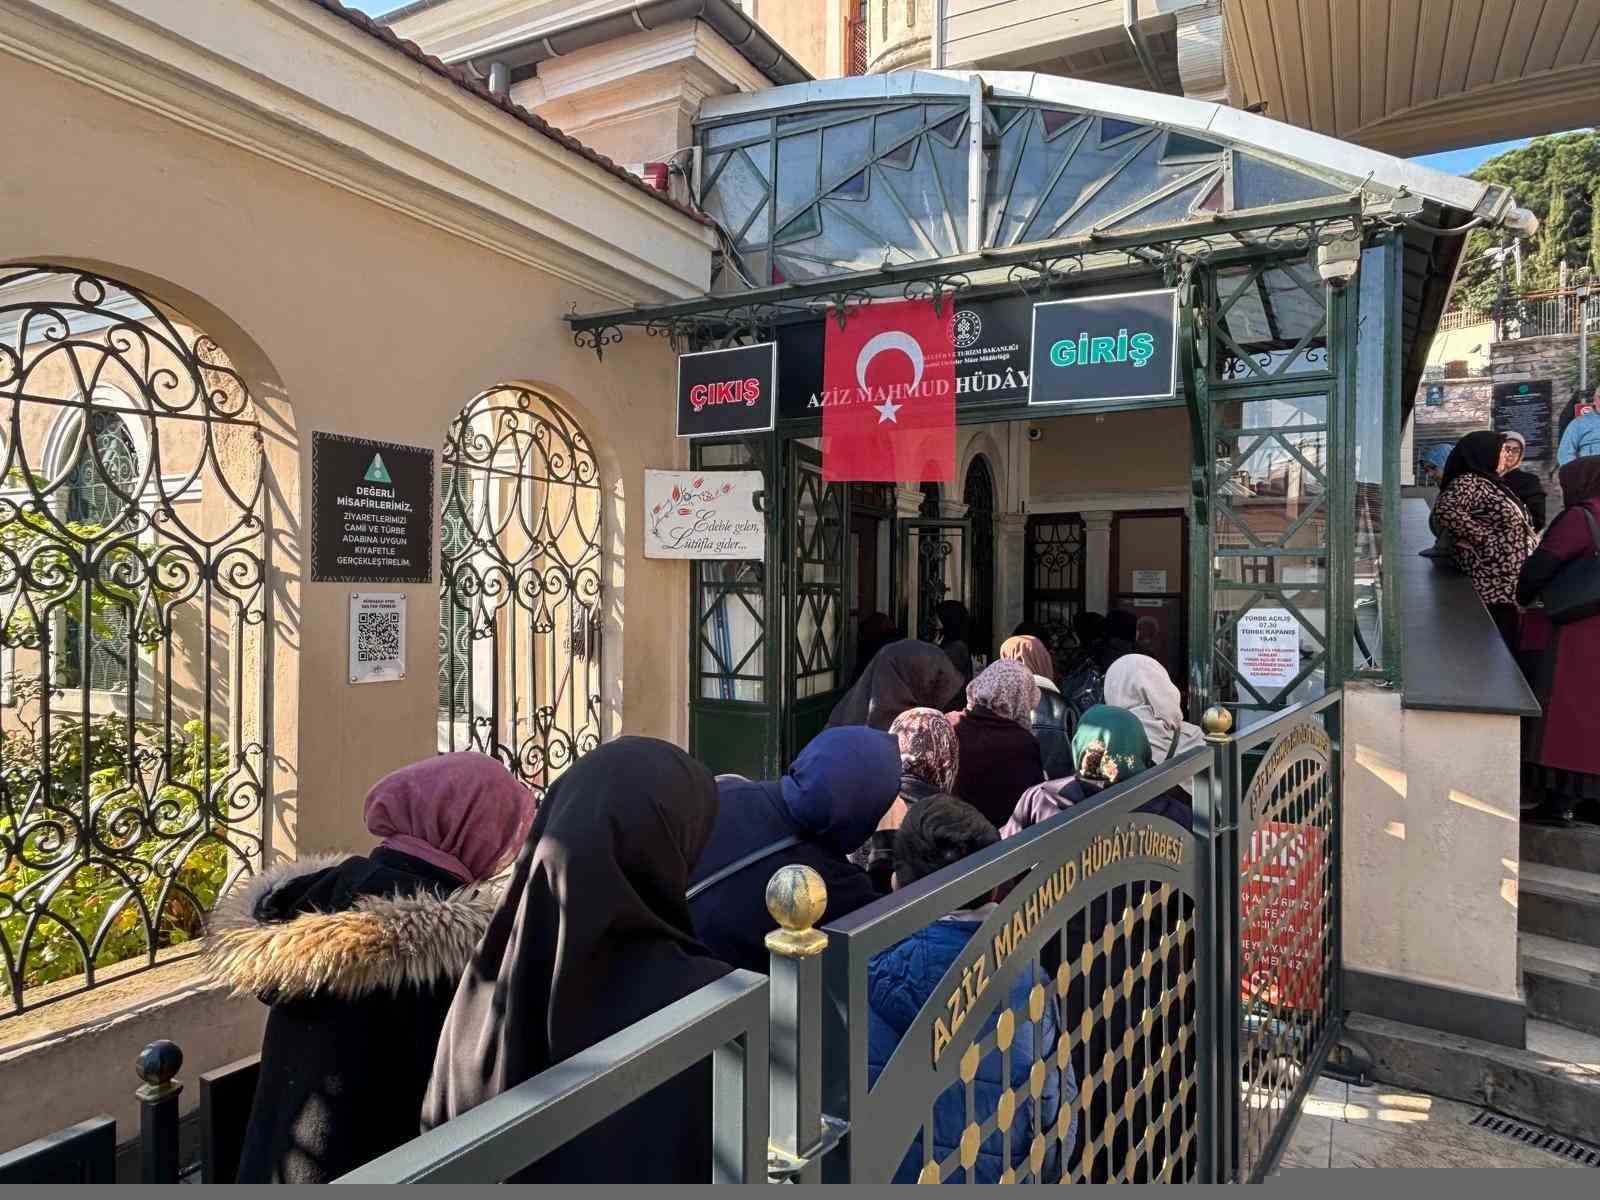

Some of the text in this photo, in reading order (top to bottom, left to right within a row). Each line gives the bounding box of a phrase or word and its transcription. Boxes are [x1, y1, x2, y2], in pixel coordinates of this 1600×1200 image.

[983, 343, 1019, 354] BAKANLIĞI
[1050, 328, 1154, 367] GİRİŞ
[690, 378, 760, 412] ÇIKIŞ
[807, 386, 851, 408] AZİZ
[856, 379, 949, 405] MAHMUD
[356, 486, 395, 498] DEĞERLİ
[343, 512, 407, 524] ZİYARETLERİMİZİ
[368, 525, 379, 533] VE
[381, 525, 406, 535] TÜRBE
[342, 534, 407, 545] ADABINA UYGUN
[354, 546, 396, 555] KIYAFETLE
[931, 953, 990, 1066] AZİZ
[992, 860, 1077, 969] MAHMUD
[1138, 824, 1184, 865] TÜRBESİ
